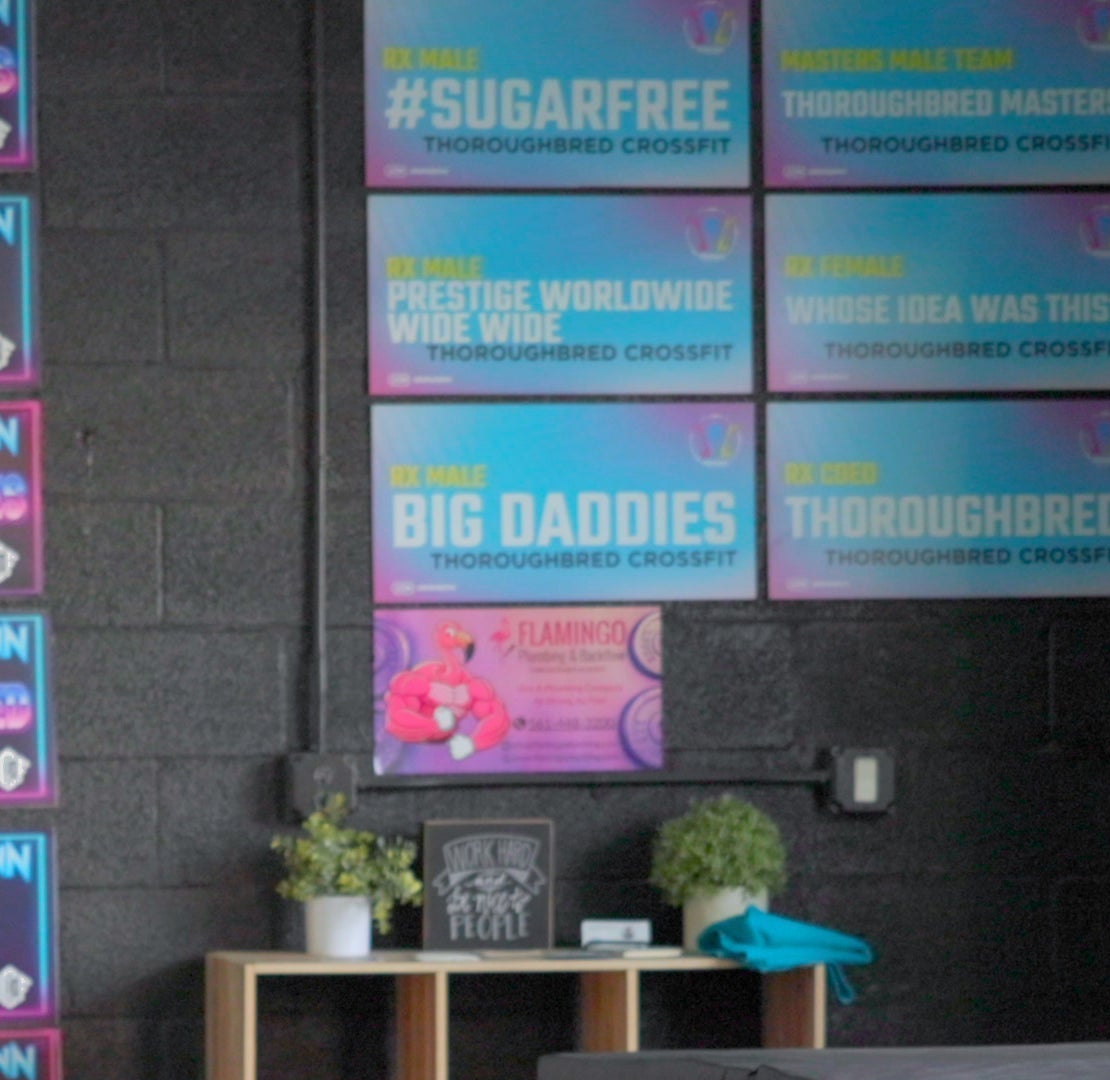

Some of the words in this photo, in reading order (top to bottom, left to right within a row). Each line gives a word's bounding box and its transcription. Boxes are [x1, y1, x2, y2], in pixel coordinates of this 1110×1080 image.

[419, 47, 480, 71] MALE
[781, 49, 883, 72] MASTERS
[889, 48, 949, 71] MALE
[955, 48, 1015, 71] TEAM
[384, 78, 732, 131] #SUGARFREE
[783, 89, 993, 118] THOROUGHBRED
[424, 136, 614, 154] THOROUGHBRED
[622, 137, 731, 154] CROSSFIT
[822, 135, 1009, 154] THOROUGHBRED
[422, 256, 484, 279] MALE
[821, 255, 905, 278] FEMALE
[387, 280, 531, 312] PRESTIGE
[539, 280, 734, 311] WORLDWIDE
[785, 296, 889, 325] WHOSE
[898, 295, 964, 324] IDEA
[971, 294, 1039, 324] WAS
[387, 313, 471, 344] WIDE
[479, 313, 564, 343] WIDE
[426, 344, 617, 362] THOROUGHBRED
[624, 344, 734, 361] CROSSFIT
[824, 341, 1012, 360] THOROUGHBRED
[425, 465, 487, 488] MALE
[392, 492, 485, 549] BIG
[500, 490, 737, 547] DADDIES
[431, 550, 620, 570] THOROUGHBRED
[628, 549, 739, 568] CROSSFIT
[825, 547, 1012, 566] THOROUGHBRED
[518, 620, 627, 647] FLAMINGO
[447, 840, 494, 872] WORK
[497, 839, 532, 869] HARD
[449, 913, 531, 941] PEOPLE
